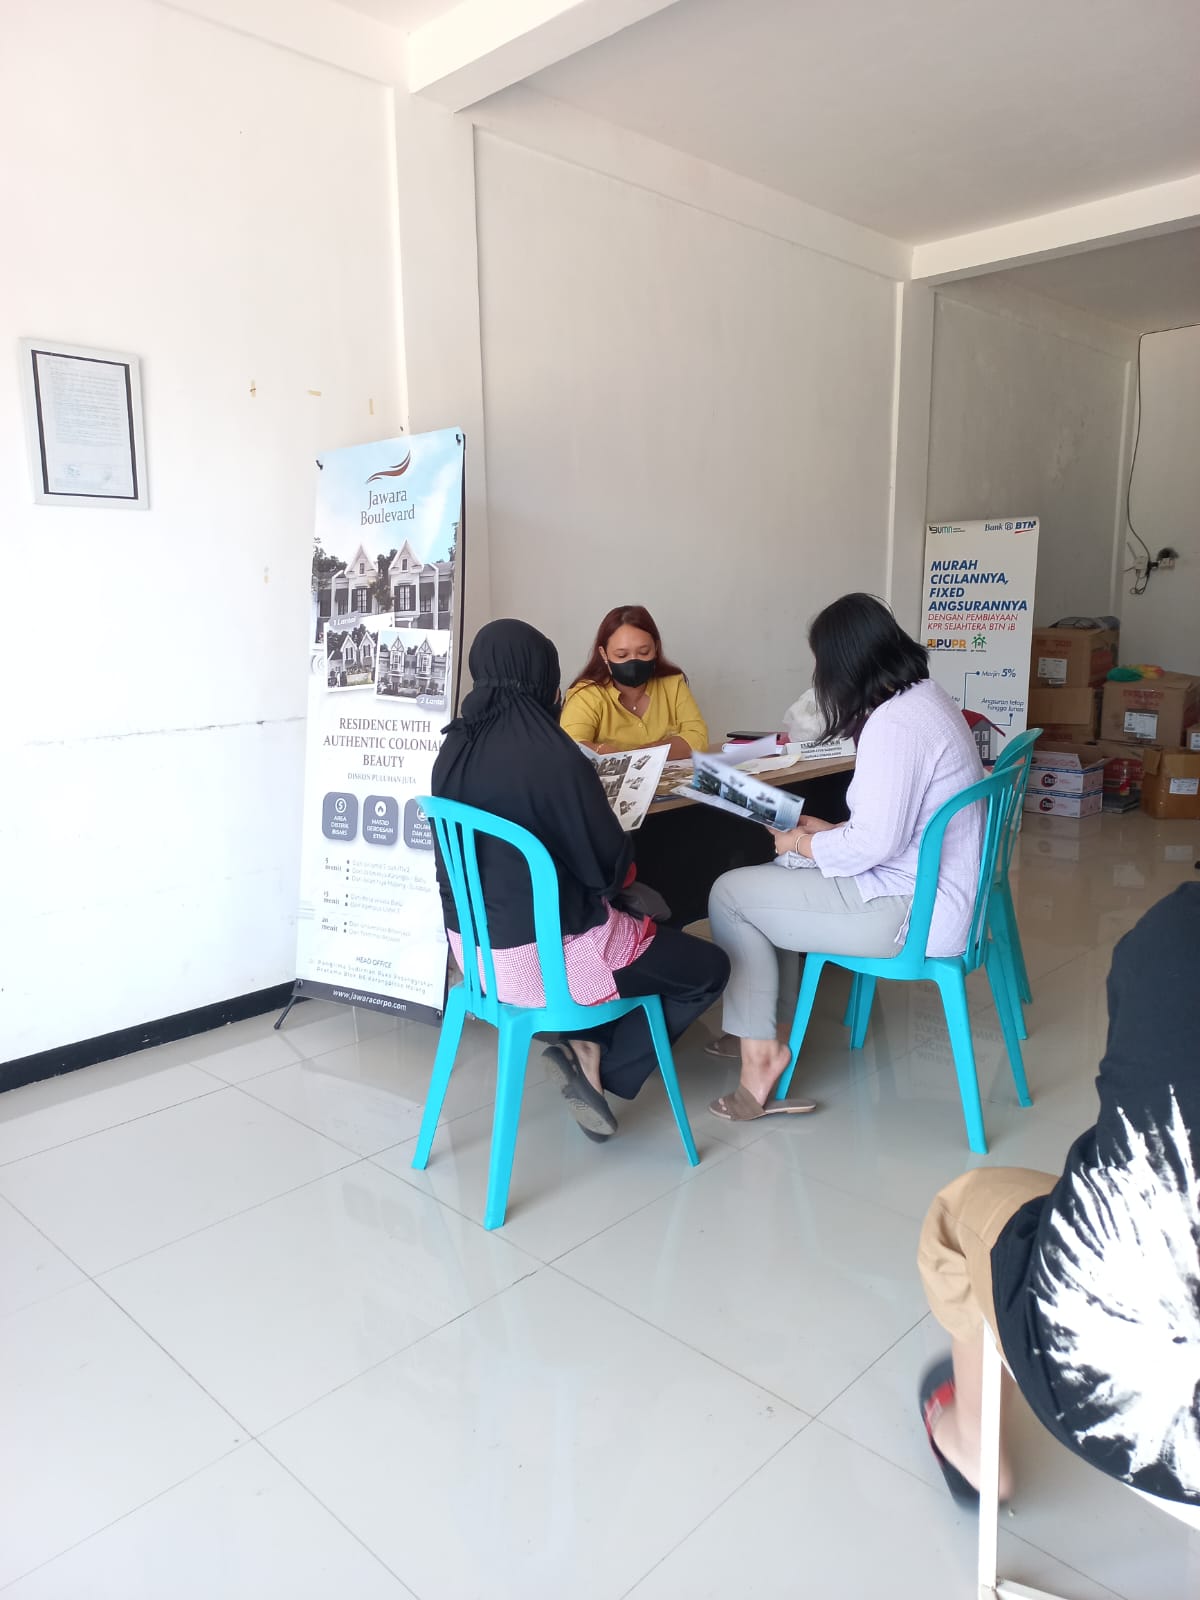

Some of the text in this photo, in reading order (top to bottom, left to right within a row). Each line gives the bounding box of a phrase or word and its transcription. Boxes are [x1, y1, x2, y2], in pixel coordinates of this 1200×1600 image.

[367, 490, 407, 510] Jawara
[360, 504, 415, 526] Boulevard
[984, 520, 1037, 532] Bank BTN
[930, 560, 978, 572] MURAH
[930, 572, 1009, 585] CICILANNYA,
[930, 587, 965, 598] FIXED
[928, 600, 1028, 612] ANGSURANNYA
[928, 613, 1018, 621] DENGAN PEMBIAYAAN
[927, 622, 1016, 631] KPR SEJAHTERA BTN iB
[936, 638, 967, 648] PUPR
[1001, 668, 1017, 678] 5%
[340, 718, 431, 732] RESIDENCE WITH
[323, 735, 387, 749] AUTHENTIC
[363, 754, 405, 768] BEAUTY
[356, 956, 392, 968] HEAD OFFICE
[332, 989, 407, 1012] www.jawaracorpo.com
